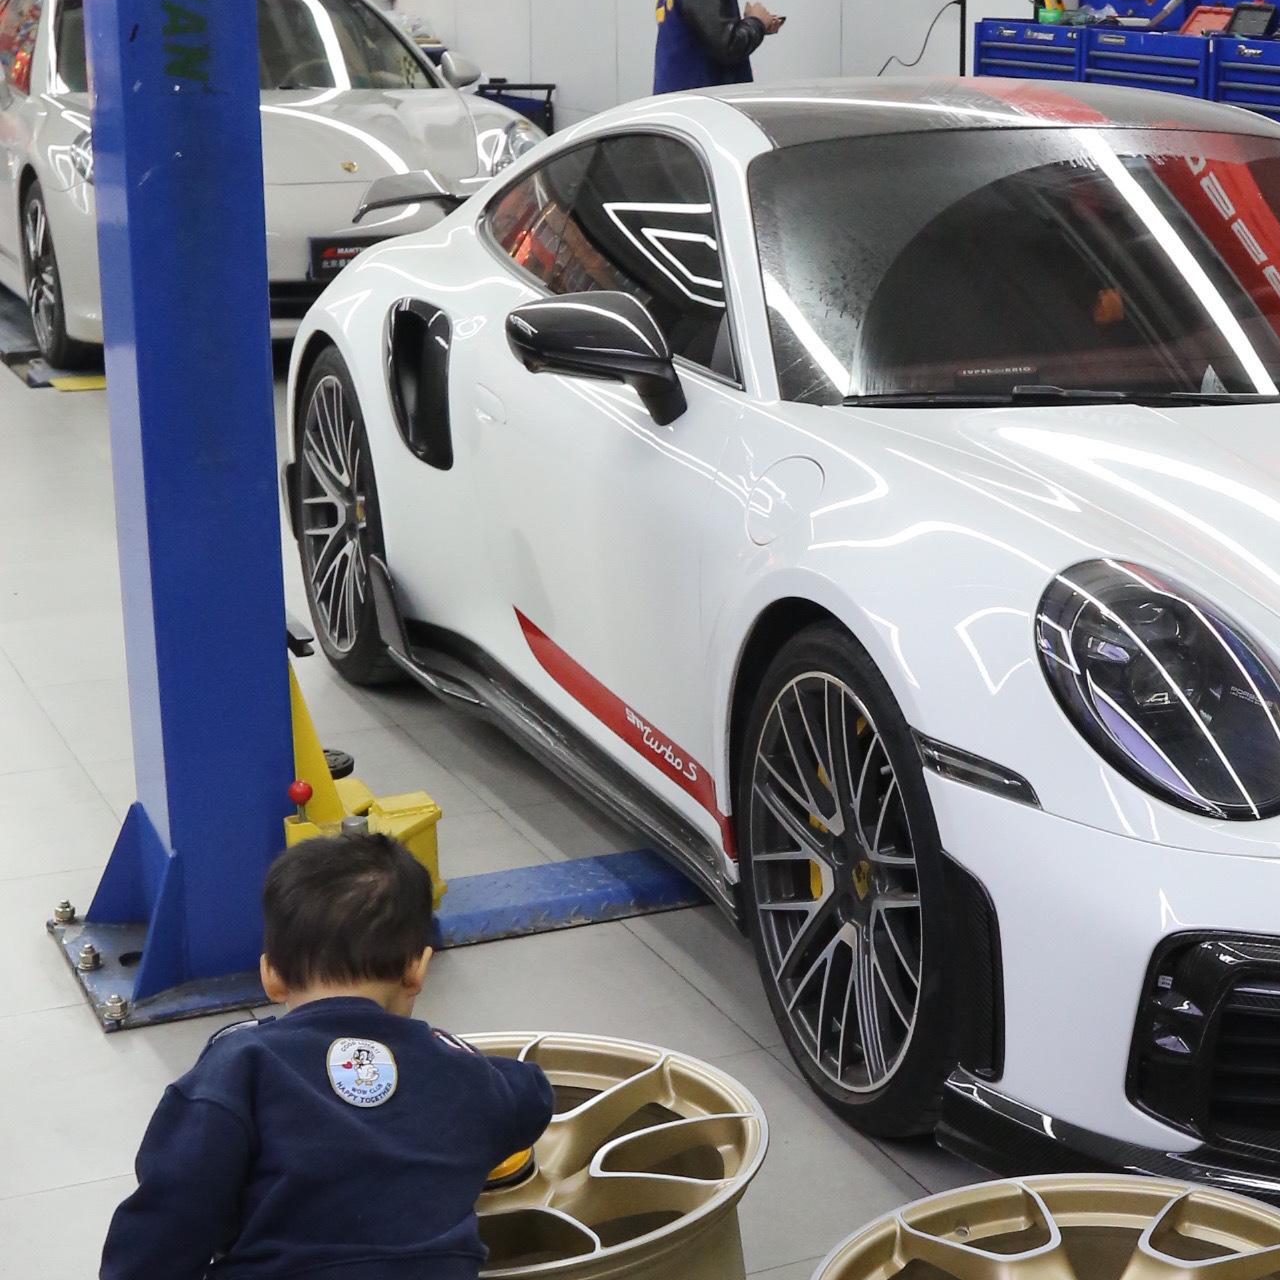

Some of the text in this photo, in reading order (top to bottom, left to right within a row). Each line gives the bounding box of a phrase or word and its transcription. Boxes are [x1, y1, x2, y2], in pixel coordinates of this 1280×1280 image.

[643, 726, 682, 770] turbo
[683, 762, 697, 781] S
[336, 1081, 392, 1103] HAPPY TOGETHER
